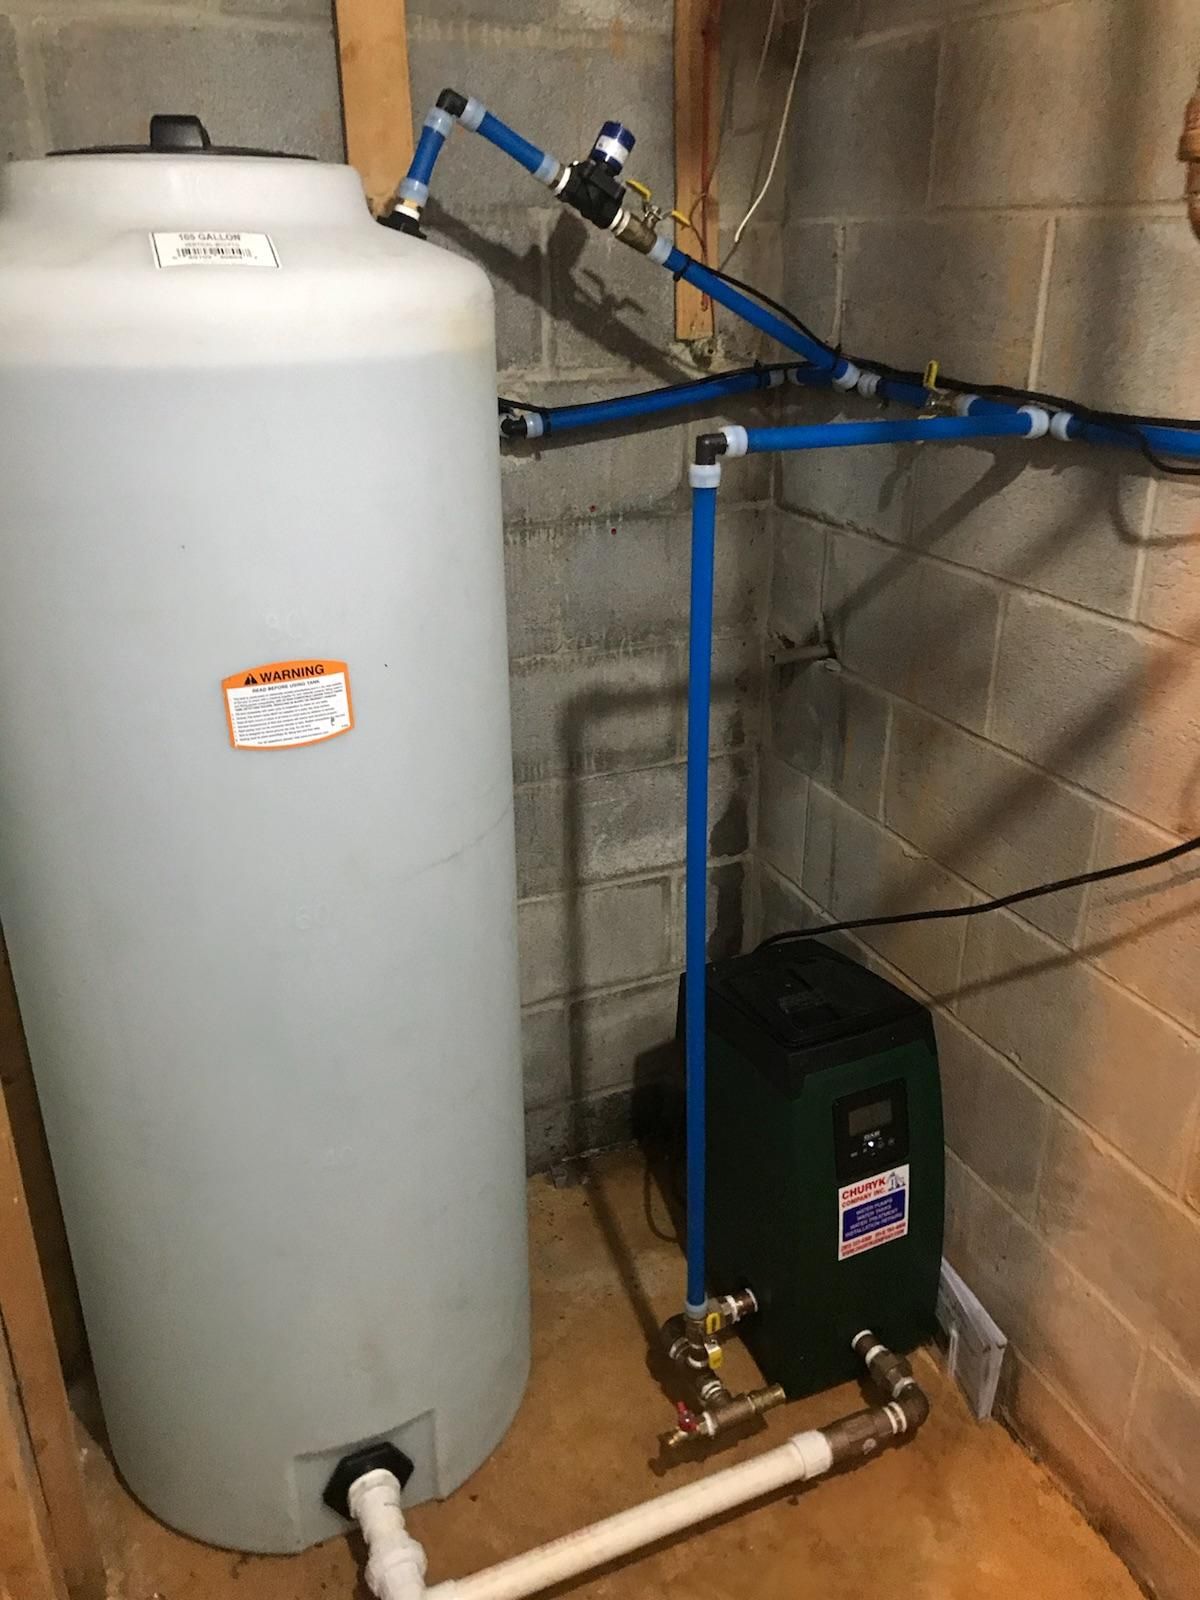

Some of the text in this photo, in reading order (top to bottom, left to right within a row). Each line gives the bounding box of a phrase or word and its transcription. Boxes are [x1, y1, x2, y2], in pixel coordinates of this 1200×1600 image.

[198, 233, 241, 241] GALLON
[259, 664, 325, 683] WARNING
[252, 679, 320, 694] READ BEFORE USING TANK
[842, 1177, 886, 1200] CHURYK
[841, 1193, 873, 1208] COMPANY
